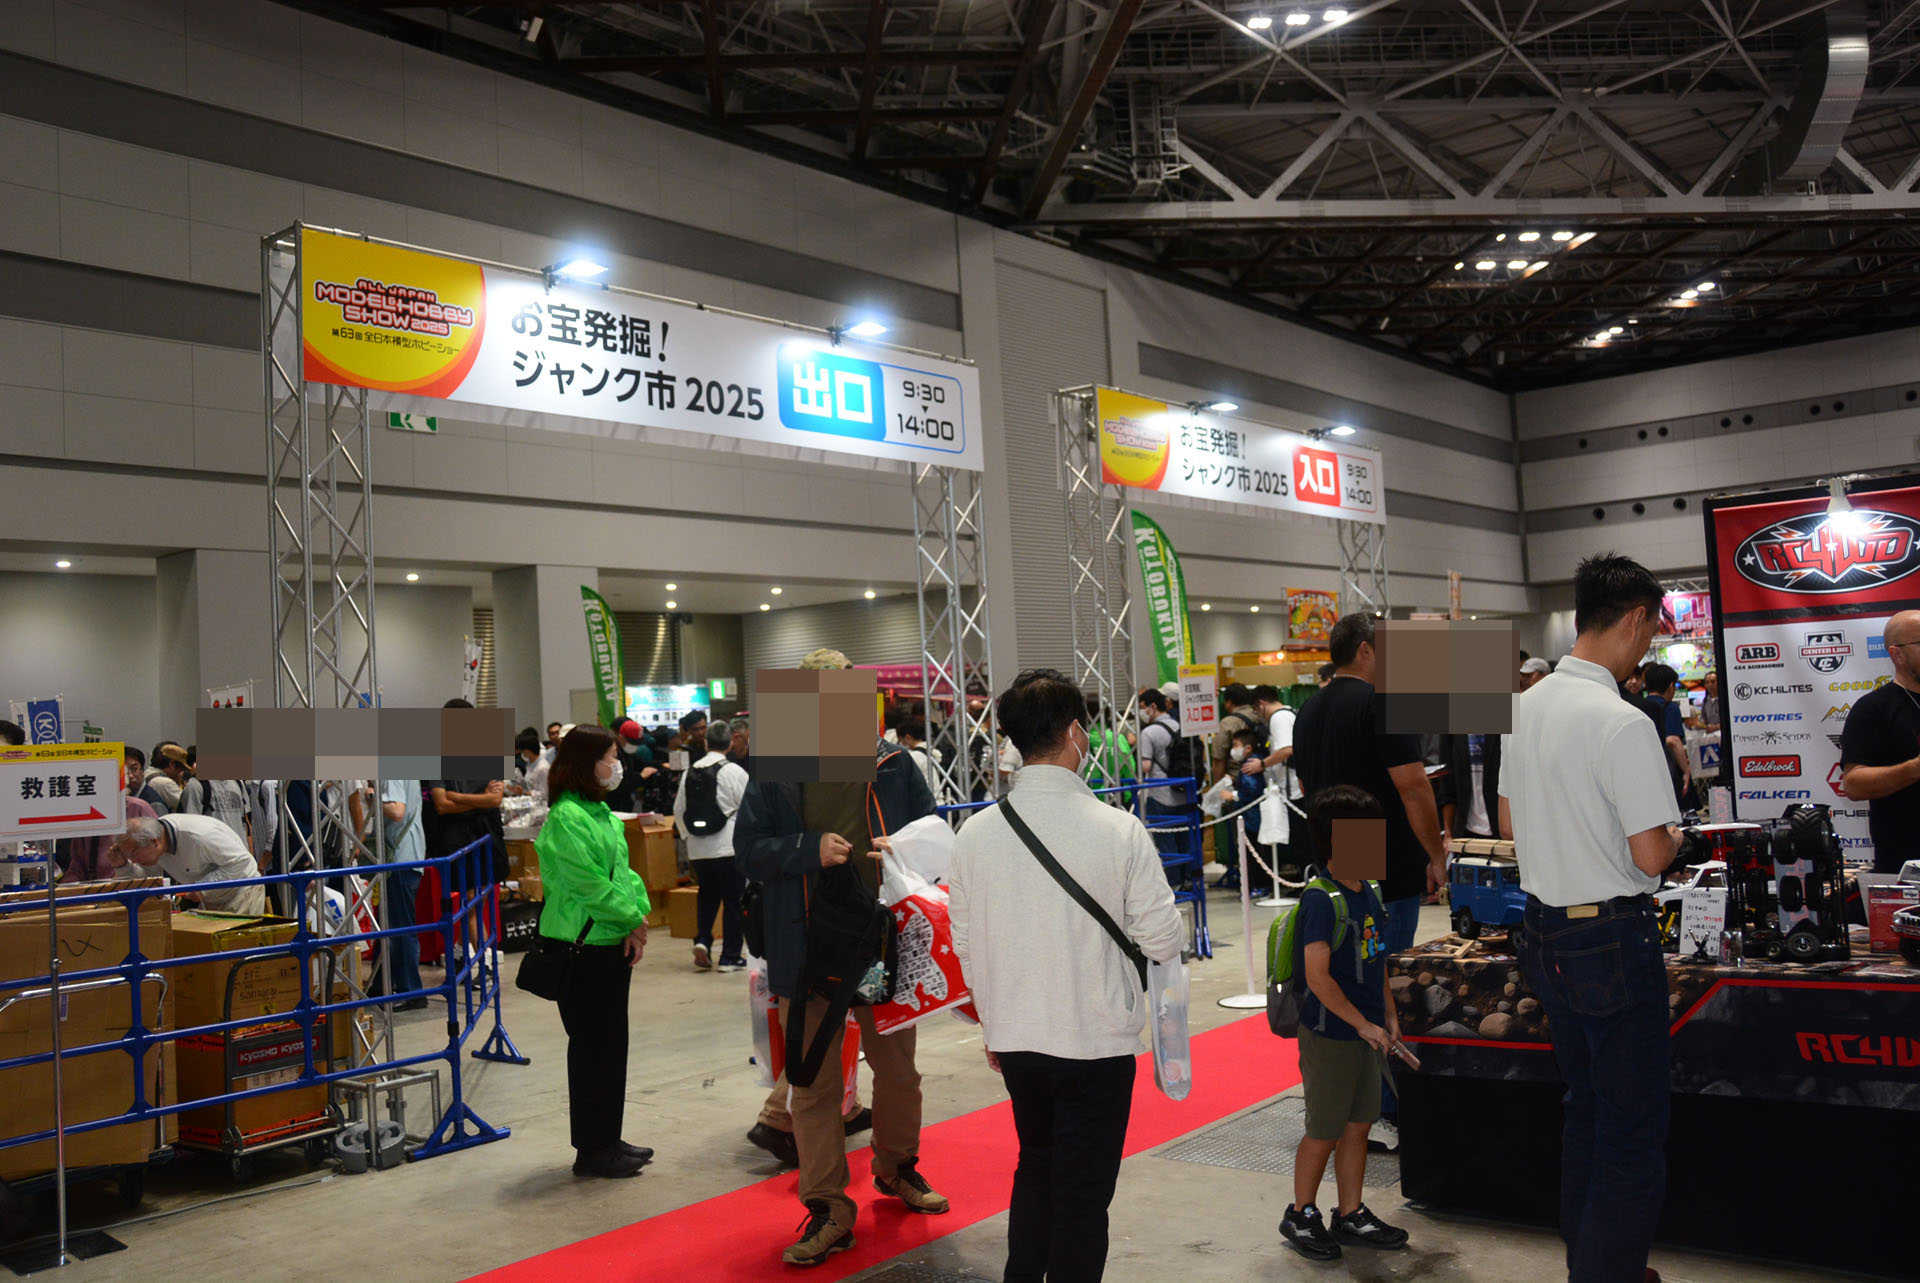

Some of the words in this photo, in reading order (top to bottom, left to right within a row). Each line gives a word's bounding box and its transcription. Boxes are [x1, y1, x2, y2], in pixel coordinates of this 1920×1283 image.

[358, 279, 386, 293] ALL
[389, 286, 435, 302] JAPAN
[343, 303, 410, 330] SHOW
[410, 319, 449, 335] 2025
[512, 301, 669, 362] お宝発掘!
[513, 350, 676, 411] ジャンク市
[685, 377, 764, 421] 2025
[793, 361, 873, 424] 出口
[903, 380, 945, 404] 9:30
[897, 413, 954, 441] 14:00
[1254, 469, 1289, 496] 2025
[1299, 454, 1336, 496] 入口
[1345, 486, 1373, 505] 14:00
[1134, 527, 1179, 659] KOTOBUKIYA
[1741, 646, 1776, 660] ARB
[1802, 647, 1831, 656] CENTER
[1754, 686, 1768, 695] KC
[1734, 714, 1766, 723] TOYO
[1767, 712, 1802, 722] TIRES
[1745, 759, 1795, 773] Edelbrock
[21, 774, 96, 799] 救護室
[1739, 789, 1811, 800] FALKEN
[240, 1047, 278, 1062] KYOSHO
[281, 1038, 317, 1055] KYOSO
